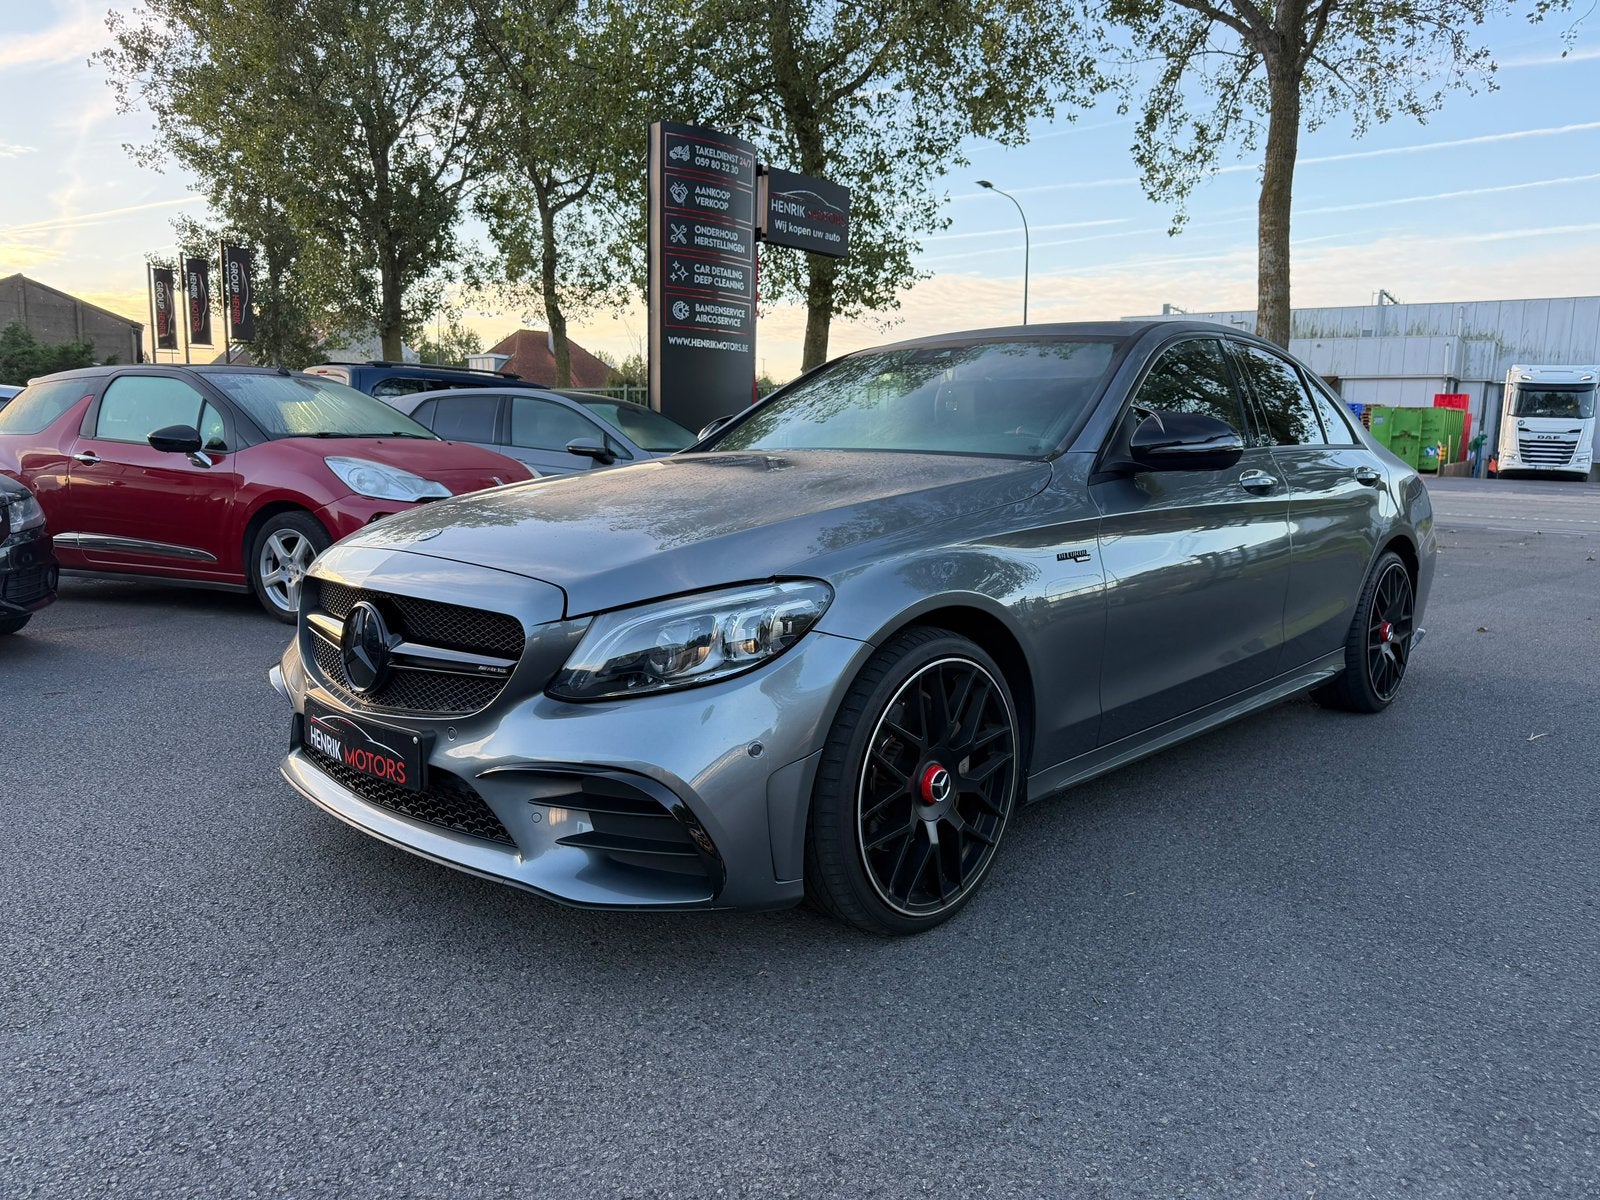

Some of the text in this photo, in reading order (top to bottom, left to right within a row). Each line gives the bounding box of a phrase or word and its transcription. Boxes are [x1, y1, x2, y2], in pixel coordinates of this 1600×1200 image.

[695, 145, 752, 168] TAKELDIENST 24/7
[695, 156, 739, 175] 059 80 32 30
[695, 186, 730, 200] AANKOOP
[695, 196, 729, 210] VERKOOP
[771, 199, 806, 218] HENRIK
[694, 225, 738, 241] ONDERHOUD
[774, 219, 841, 242] Wij kopen uw auto
[694, 236, 745, 253] HERSTELLINGEN
[694, 264, 743, 280] CAR DETAILING
[694, 275, 745, 290] DEEP CLEANING
[156, 281, 165, 309] GROUP
[230, 261, 241, 325] GROUP HENRIK
[190, 272, 200, 333] HENRIK MOTORS
[695, 304, 746, 318] BANDENSERVICE
[695, 315, 741, 327] AIRCOSERVICE
[668, 336, 749, 353] WWW.HENRIKMOTORS.BE
[310, 725, 407, 784] HENRIK MOTORS
